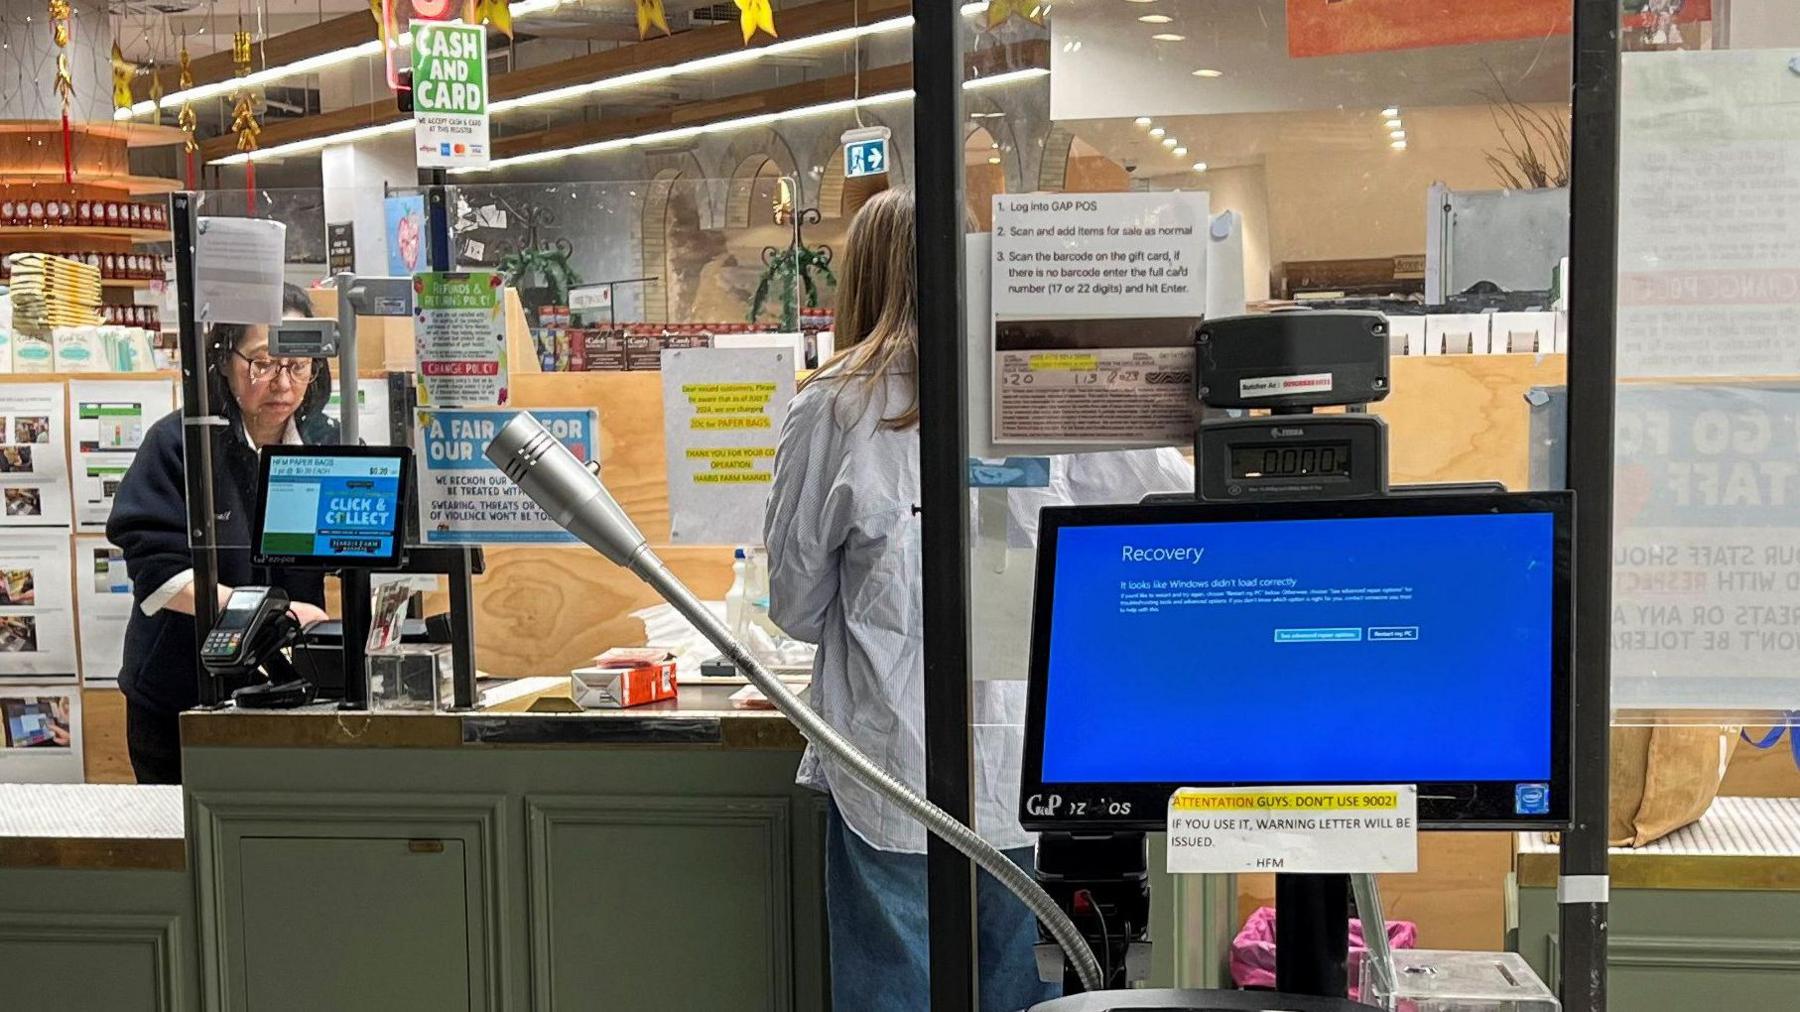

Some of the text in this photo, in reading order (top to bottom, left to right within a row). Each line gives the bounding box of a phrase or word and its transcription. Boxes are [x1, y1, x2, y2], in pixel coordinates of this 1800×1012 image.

[416, 28, 477, 59] CASH
[430, 59, 468, 81] AND
[418, 80, 480, 110] CARD
[998, 201, 1098, 213] 1. Log into GAP POS
[1010, 227, 1034, 236] Scan
[1036, 226, 1054, 236] and
[1057, 226, 1076, 236] add
[1078, 226, 1104, 236] items
[1106, 226, 1120, 236] for
[1122, 226, 1142, 236] sale
[1158, 226, 1193, 236] normal
[1009, 252, 1034, 262] Scan
[1036, 252, 1051, 261] the
[1053, 251, 1092, 261] barcode
[1096, 253, 1108, 261] on
[1110, 251, 1126, 260] the
[1128, 251, 1144, 263] gift
[1147, 251, 1172, 262] card,
[1174, 250, 1180, 260] if
[1009, 268, 1034, 277] there
[1036, 268, 1044, 277] is
[1060, 268, 1100, 277] barcode
[1103, 268, 1128, 277] enter
[1130, 268, 1146, 277] the
[1149, 267, 1164, 276] full
[1166, 266, 1188, 276] card
[473, 283, 481, 294] &
[1009, 284, 1045, 294] number
[1048, 284, 1062, 295] (17
[1078, 284, 1090, 294] 22
[1092, 284, 1122, 295] digits)
[1125, 284, 1143, 294] and
[1146, 284, 1158, 294] hit
[1160, 284, 1189, 294] Enter.
[430, 420, 444, 439] A
[452, 420, 494, 440] FAIR
[431, 441, 472, 461] OUR
[436, 476, 507, 486] WE RECKON OUR
[448, 486, 458, 496] BE
[461, 487, 500, 496] TREATED
[330, 498, 386, 512] CLICK &
[431, 501, 535, 511] SWEARING, THREATS OR
[430, 511, 532, 521] OF VIOLENCE WON'T BE
[1122, 545, 1204, 564] Recovery
[1120, 577, 1297, 590] It looks like Windows didn't load correctly
[1172, 796, 1254, 808] ATTENTATION
[1295, 796, 1334, 807] DON'T
[1337, 796, 1360, 806] USE
[1363, 796, 1397, 806] 9002!
[1172, 818, 1412, 831] IF YOU USE IT, WARNING LETTER WILL BE
[1172, 836, 1216, 848] ISSUED.
[1256, 858, 1284, 868] HFM
